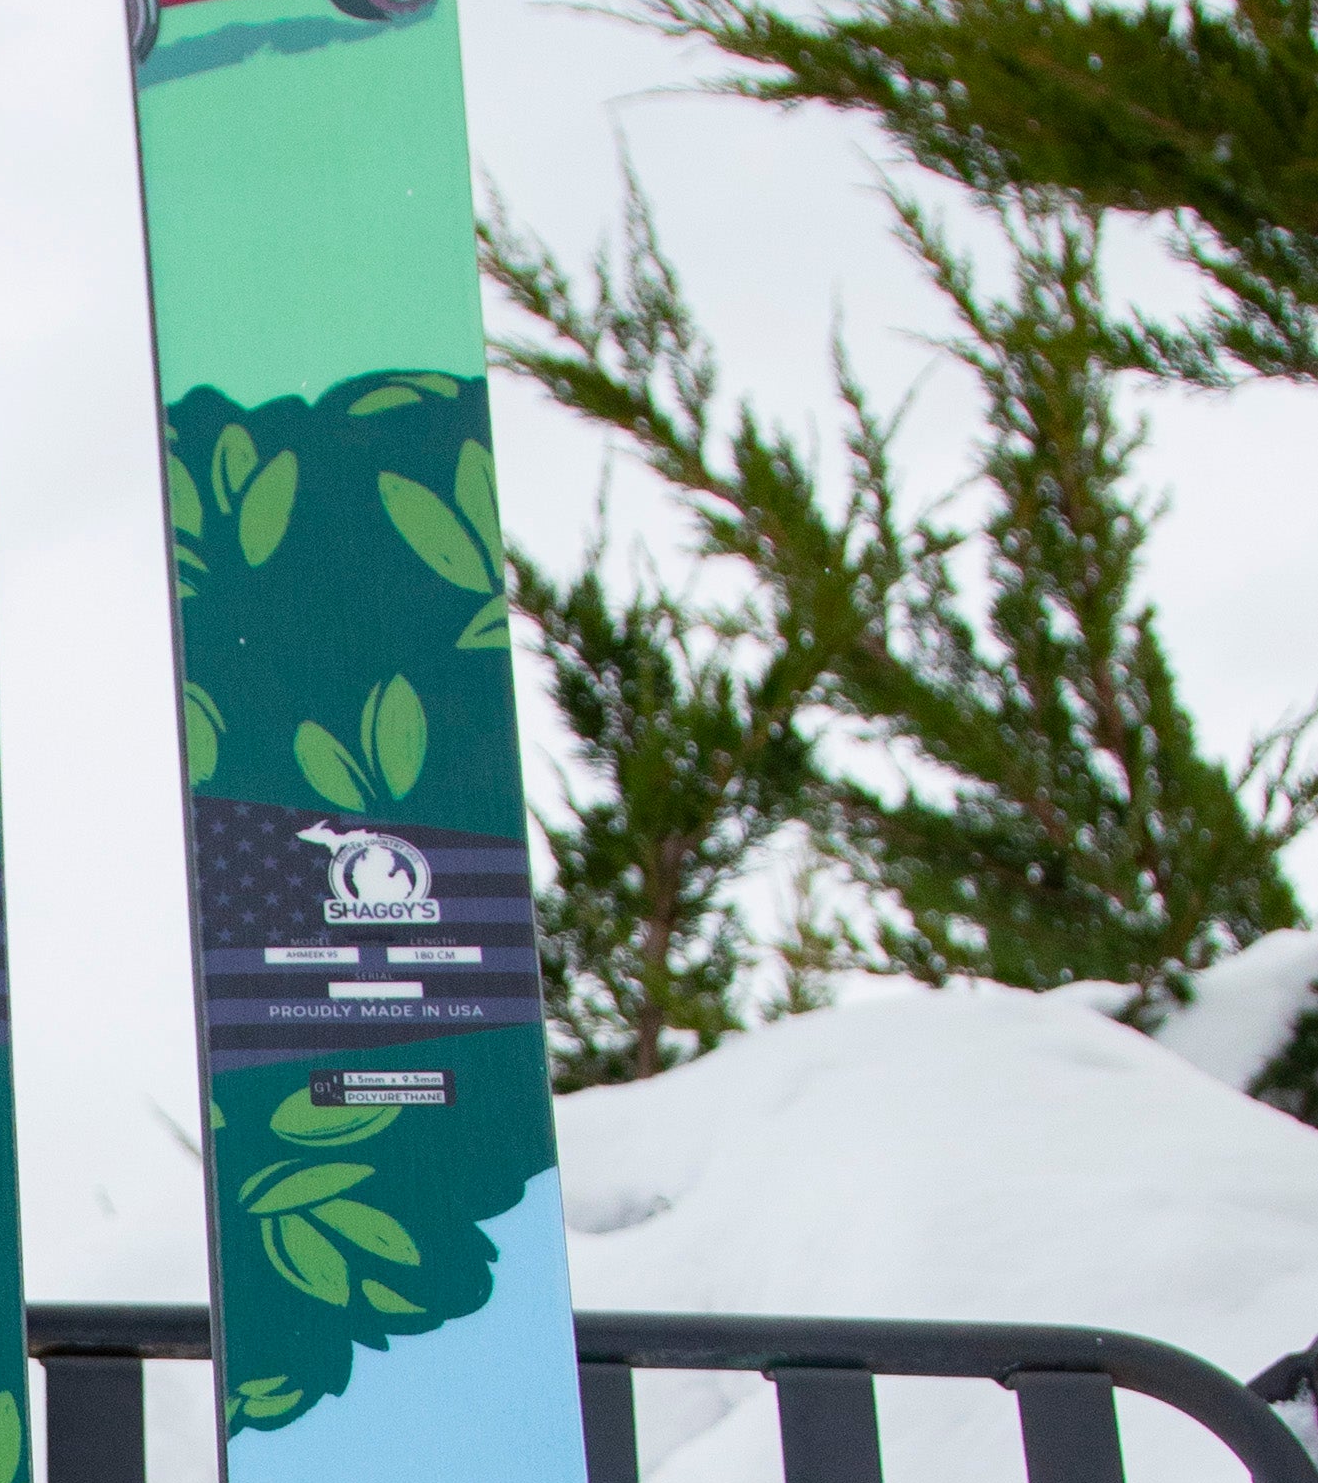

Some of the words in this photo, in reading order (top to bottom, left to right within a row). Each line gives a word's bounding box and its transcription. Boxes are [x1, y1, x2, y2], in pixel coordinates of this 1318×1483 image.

[328, 901, 436, 920] SHAGGY'S
[414, 950, 434, 960] 180
[437, 950, 456, 960] CM
[268, 1005, 352, 1018] PROUDLY
[360, 1005, 414, 1017] MADE
[422, 1005, 440, 1016] IN
[448, 1004, 484, 1016] USA
[347, 1092, 443, 1102] POLYURETHANE
